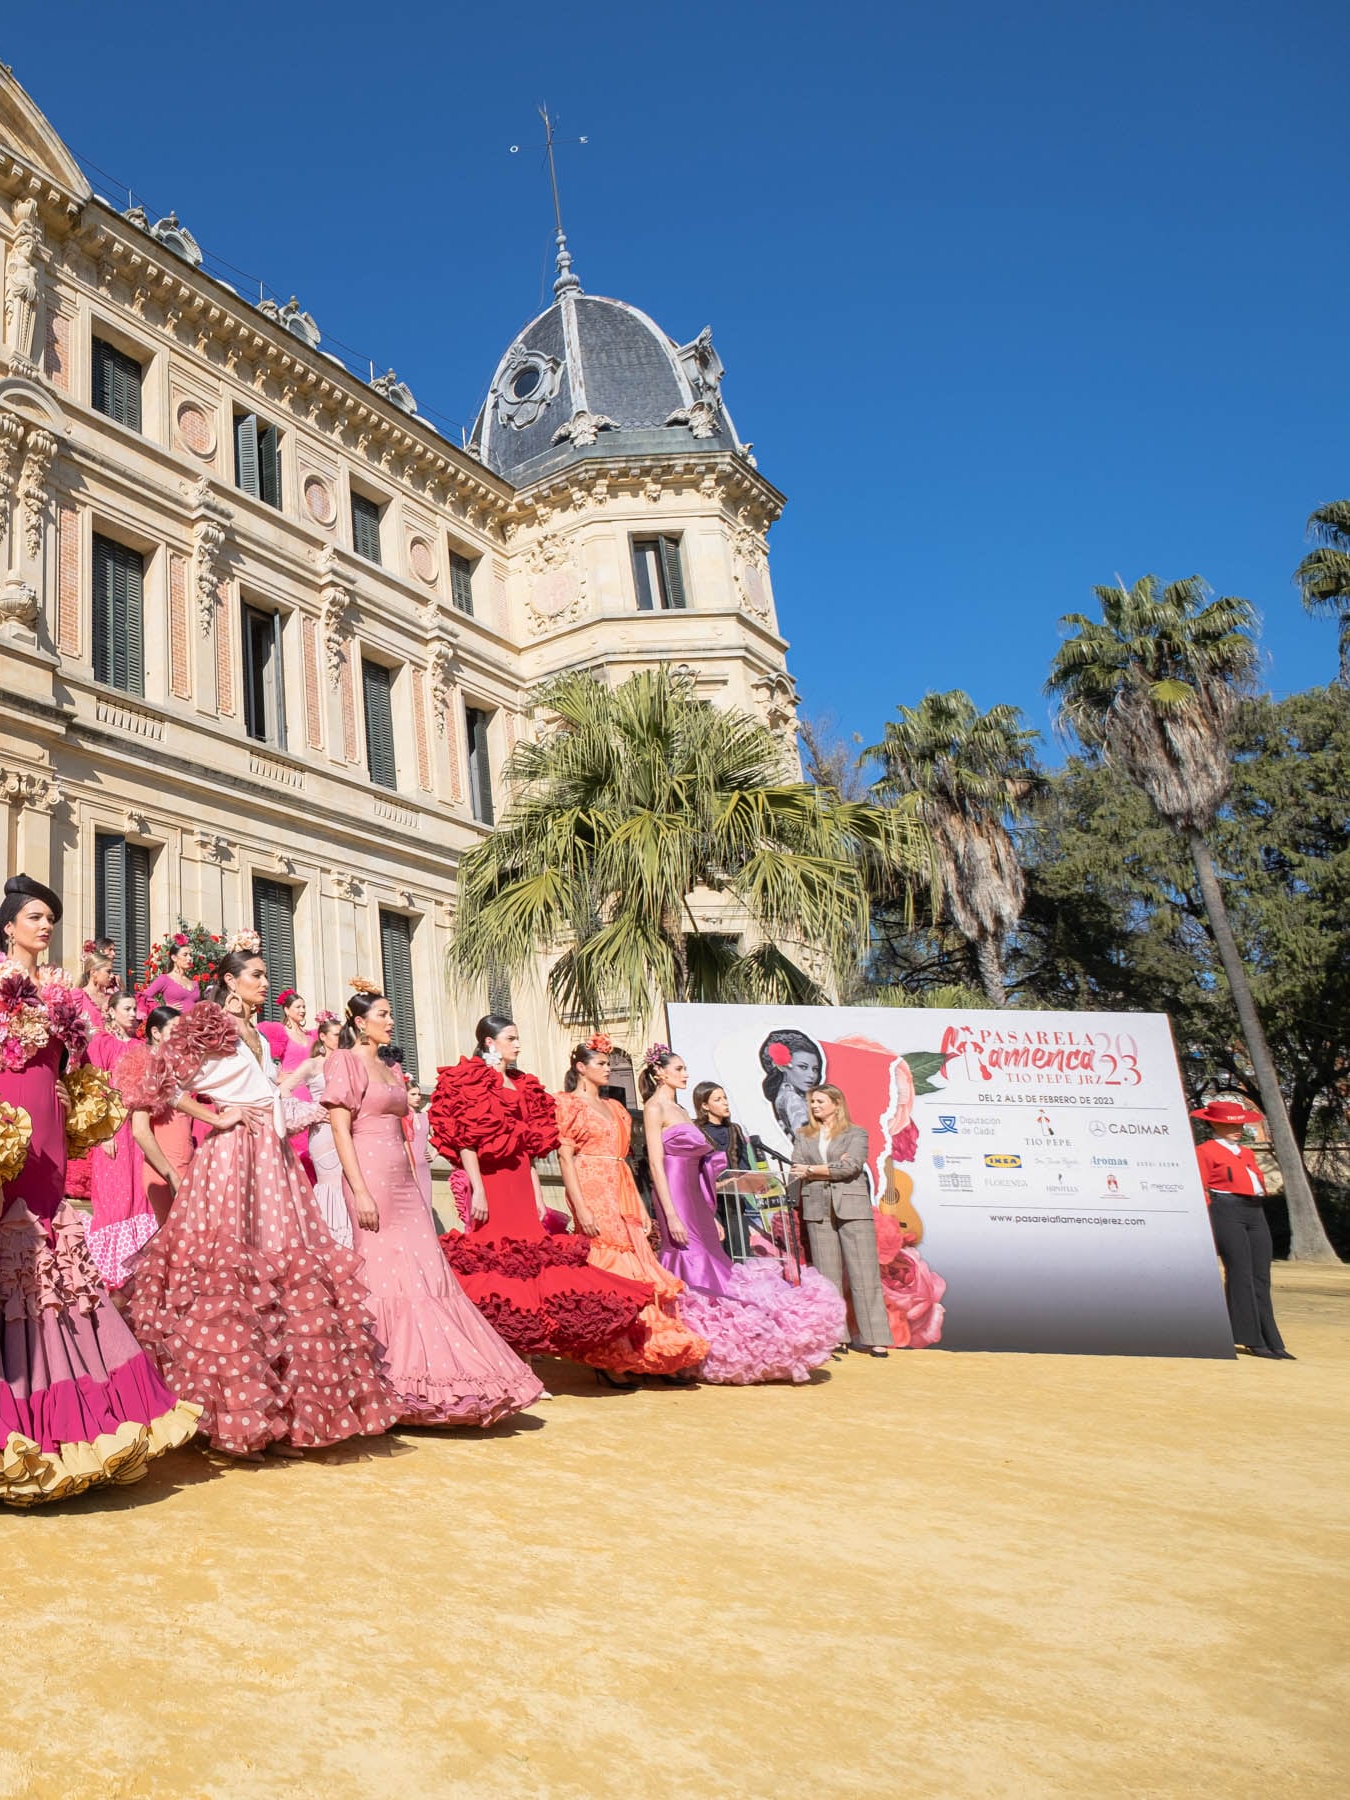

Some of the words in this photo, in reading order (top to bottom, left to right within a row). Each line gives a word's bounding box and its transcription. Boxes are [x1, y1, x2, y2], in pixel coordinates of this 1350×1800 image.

[979, 1029, 1094, 1046] PASARELA
[1006, 1072, 1032, 1083] TIO
[1037, 1073, 1072, 1084] PEPE
[978, 1094, 994, 1102] DEL
[996, 1094, 1002, 1103] 2
[1005, 1095, 1016, 1103] AL
[1017, 1095, 1023, 1103] 5
[1025, 1095, 1037, 1103] DE
[1039, 1096, 1077, 1104] FEBRERO
[1079, 1096, 1091, 1104] DE
[1093, 1097, 1114, 1105] 2023
[1109, 1123, 1169, 1136] CADIMAR
[1025, 1138, 1043, 1146] TIO
[1046, 1139, 1072, 1147] PEPE
[989, 1214, 1146, 1226] www.pasarelaflamencajerez.com
